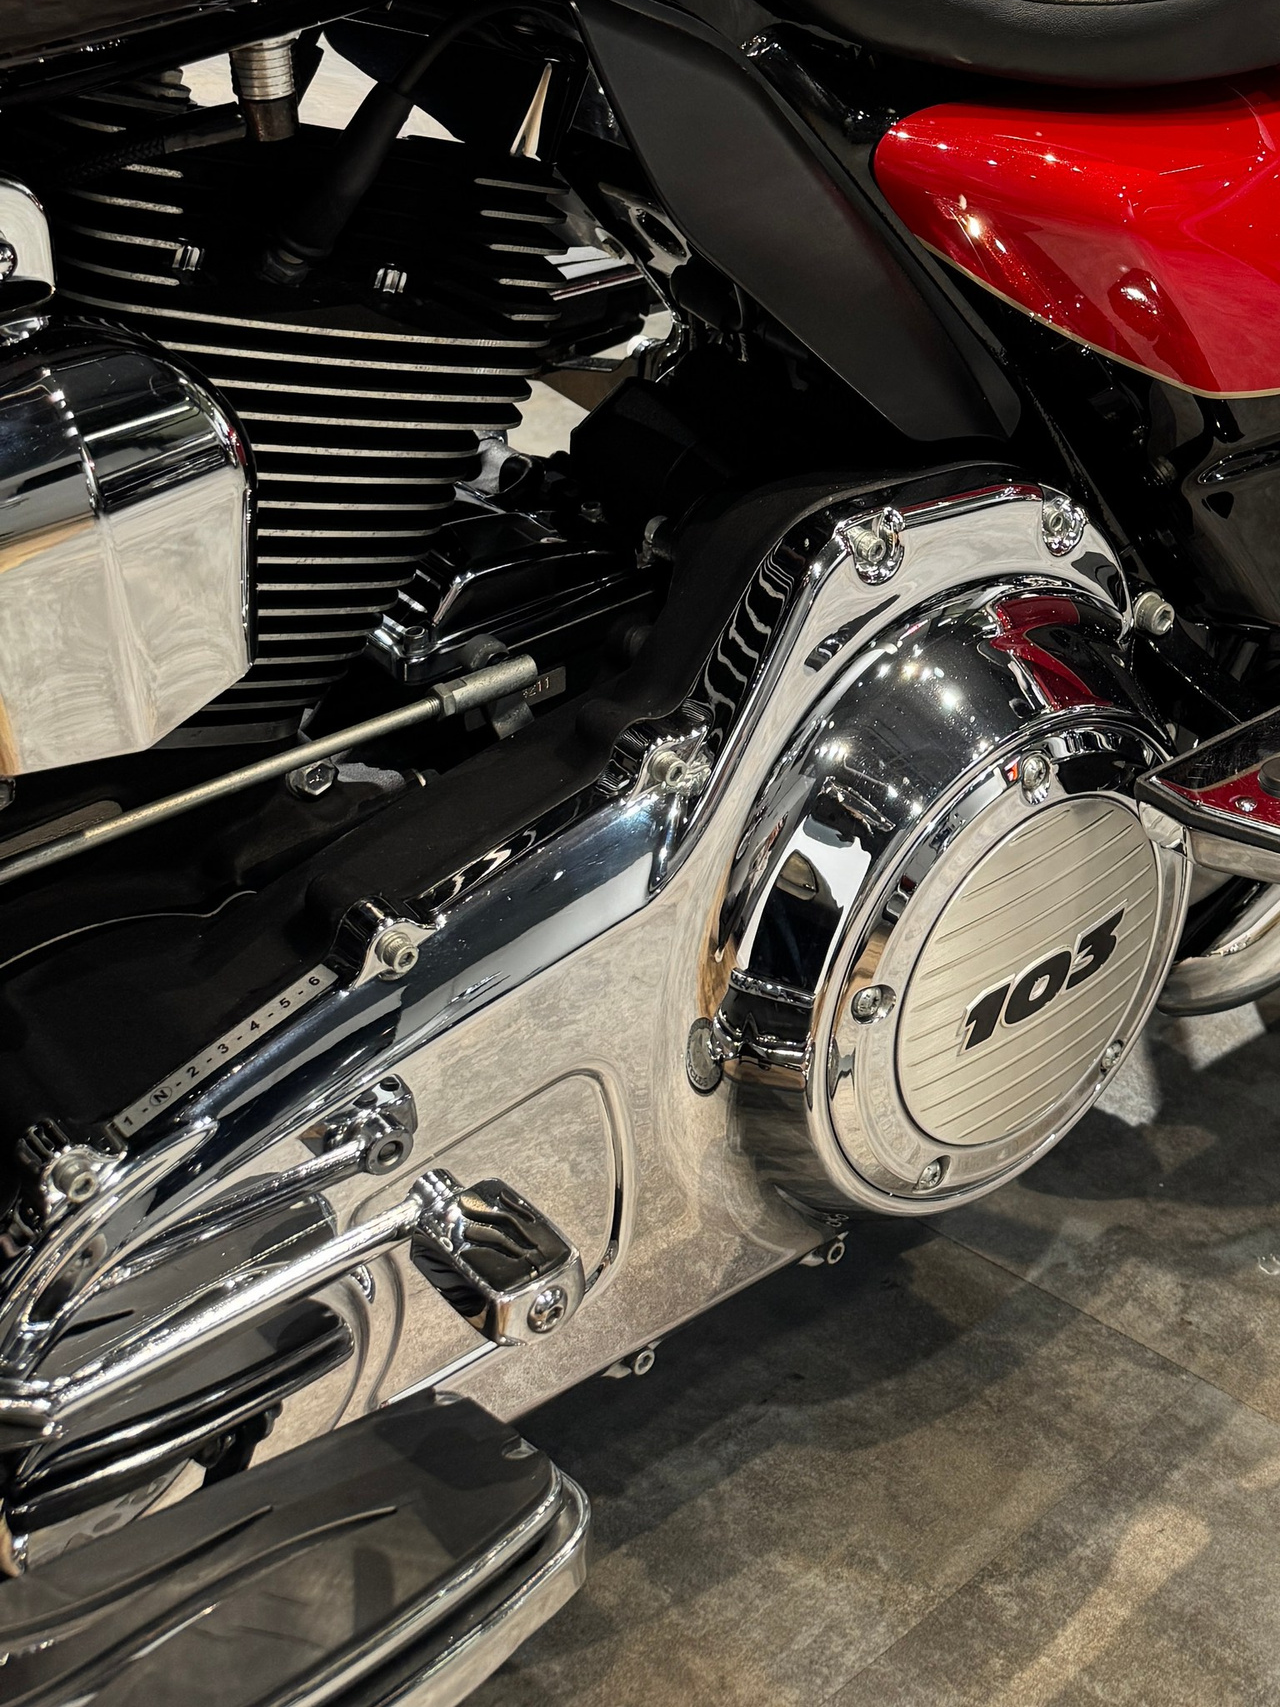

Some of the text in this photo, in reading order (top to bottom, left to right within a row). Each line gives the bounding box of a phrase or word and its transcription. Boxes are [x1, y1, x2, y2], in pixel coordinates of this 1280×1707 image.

[187, 1066, 199, 1078] 2
[217, 1043, 229, 1054] 3
[249, 1020, 260, 1031] 4
[279, 997, 291, 1008] 5
[308, 976, 320, 986] 6
[956, 899, 1128, 1056] 103
